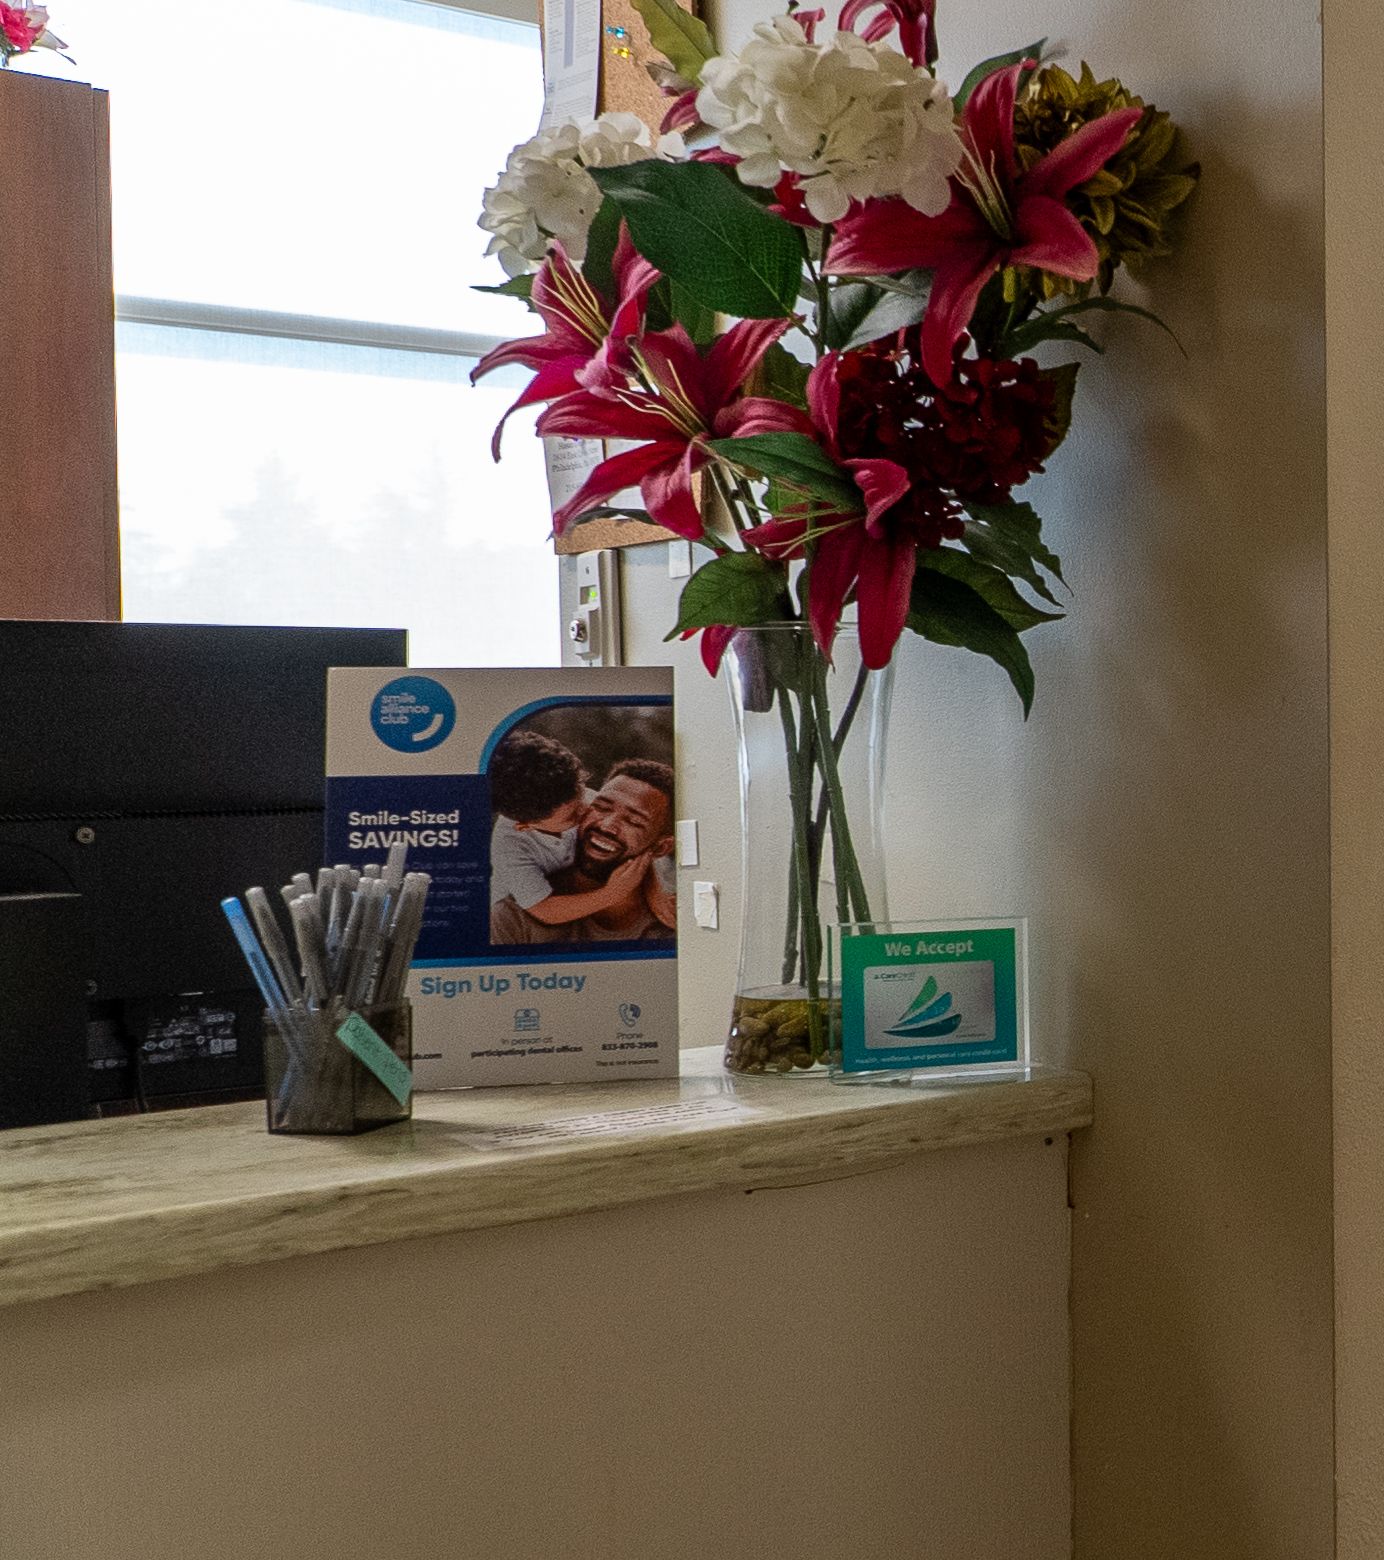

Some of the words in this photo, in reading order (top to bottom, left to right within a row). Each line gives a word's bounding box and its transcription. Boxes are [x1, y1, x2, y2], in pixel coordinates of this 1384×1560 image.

[381, 692, 416, 703] smile
[381, 704, 430, 713] alliance
[381, 713, 408, 724] club
[348, 810, 460, 826] Smile-Sized
[349, 829, 460, 849] SAVINGS!
[885, 942, 911, 957] We
[916, 940, 974, 956] Accept
[420, 976, 472, 998] Sign
[479, 975, 511, 995] Up
[516, 972, 587, 993] Today
